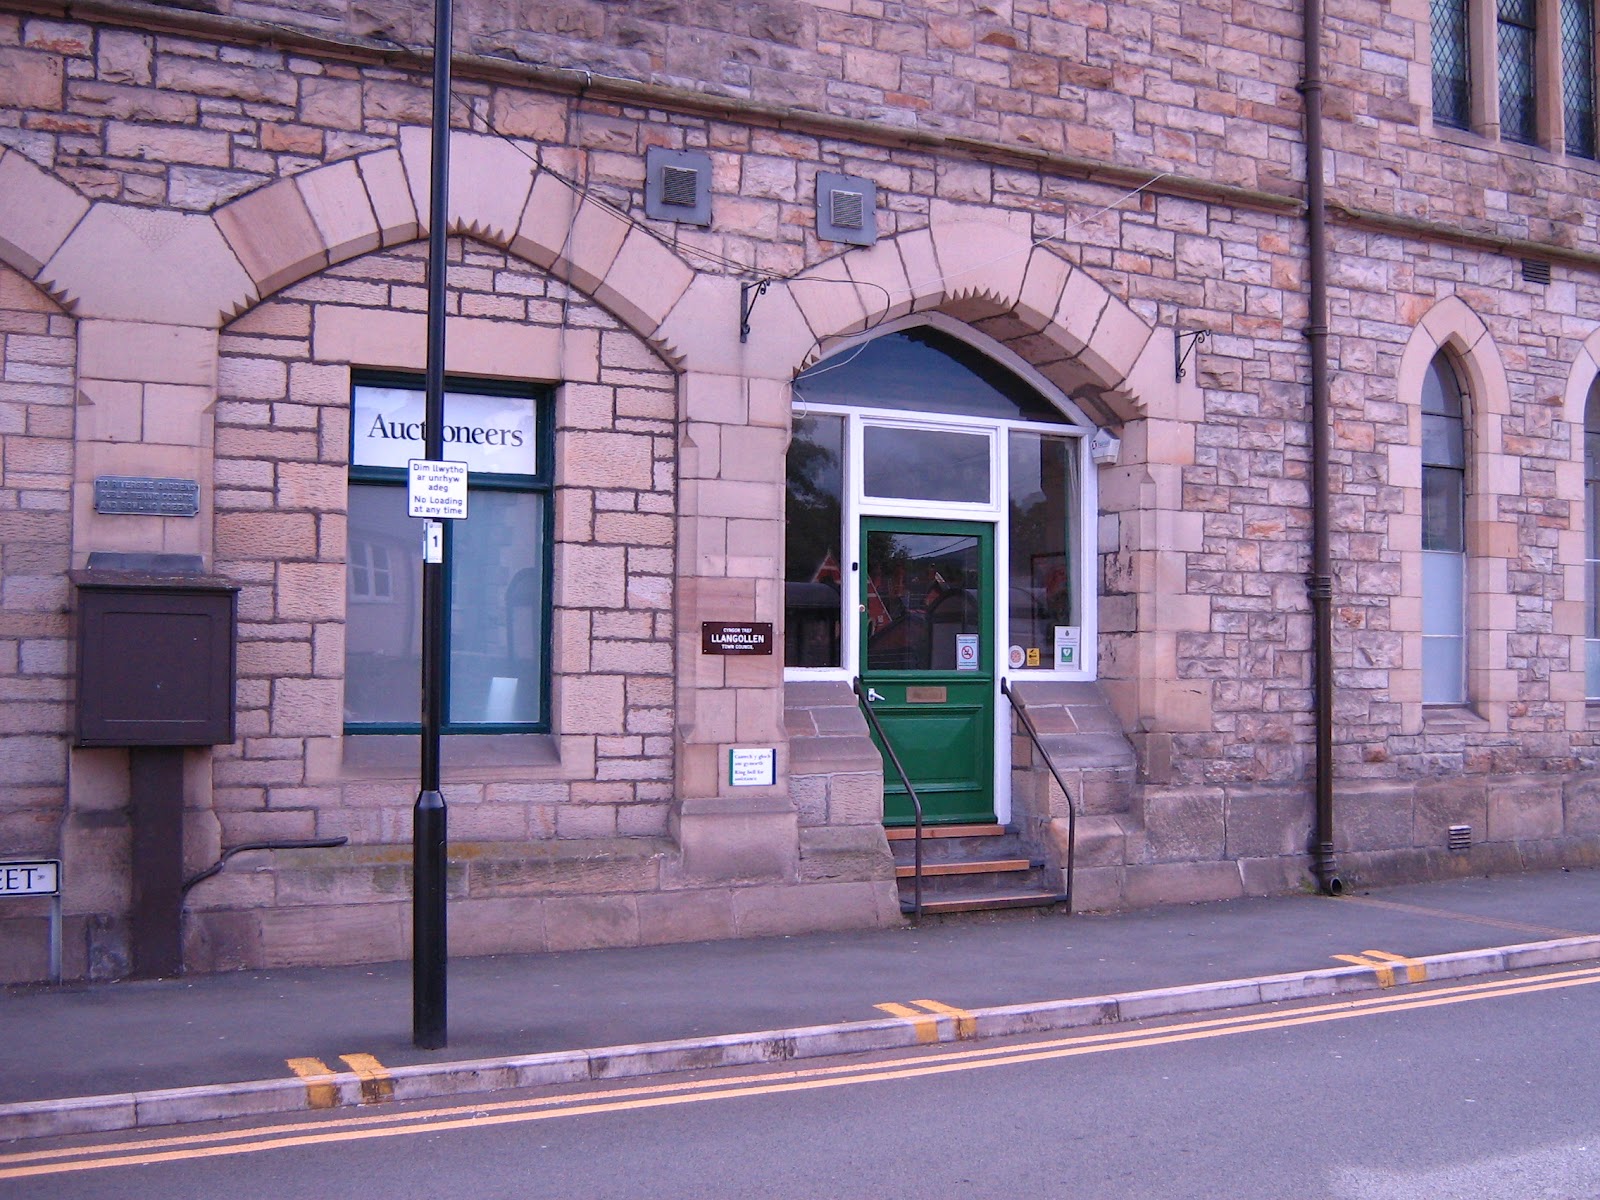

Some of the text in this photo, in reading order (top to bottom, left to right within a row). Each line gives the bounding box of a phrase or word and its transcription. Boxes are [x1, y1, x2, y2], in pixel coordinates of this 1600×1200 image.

[367, 413, 524, 447] Auctoneers
[413, 463, 464, 474] Dim llwytho
[428, 475, 460, 483] unrhyw
[112, 480, 154, 488] RIVERSIDE
[158, 482, 197, 491] GARDENS
[428, 484, 449, 492] adeg
[162, 493, 194, 501] COURTS
[414, 495, 463, 506] No Loading
[160, 502, 194, 511] GREENS
[425, 506, 440, 514] any
[443, 506, 463, 514] time
[433, 535, 438, 548] 1
[711, 634, 764, 643] LLANGOLLEN
[0, 867, 38, 889] ET
